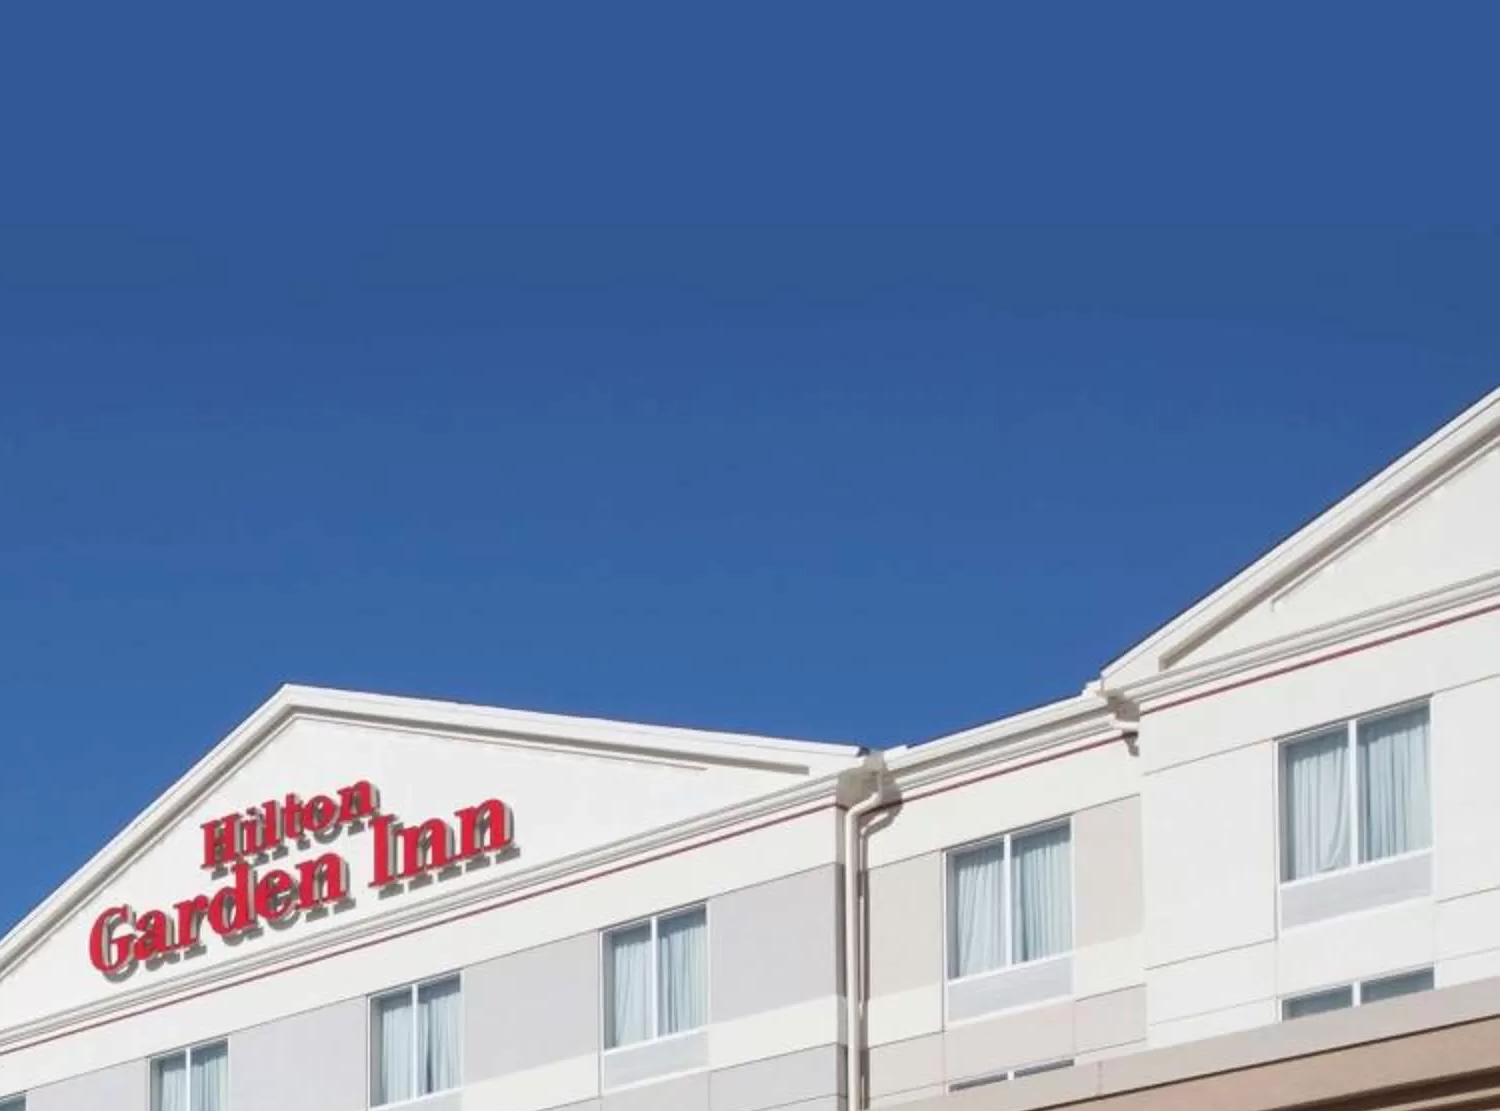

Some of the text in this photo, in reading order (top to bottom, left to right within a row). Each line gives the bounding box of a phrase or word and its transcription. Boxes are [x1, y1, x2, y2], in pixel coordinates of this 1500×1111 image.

[89, 798, 514, 974] Garden Inn
[200, 780, 378, 870] Hilton
